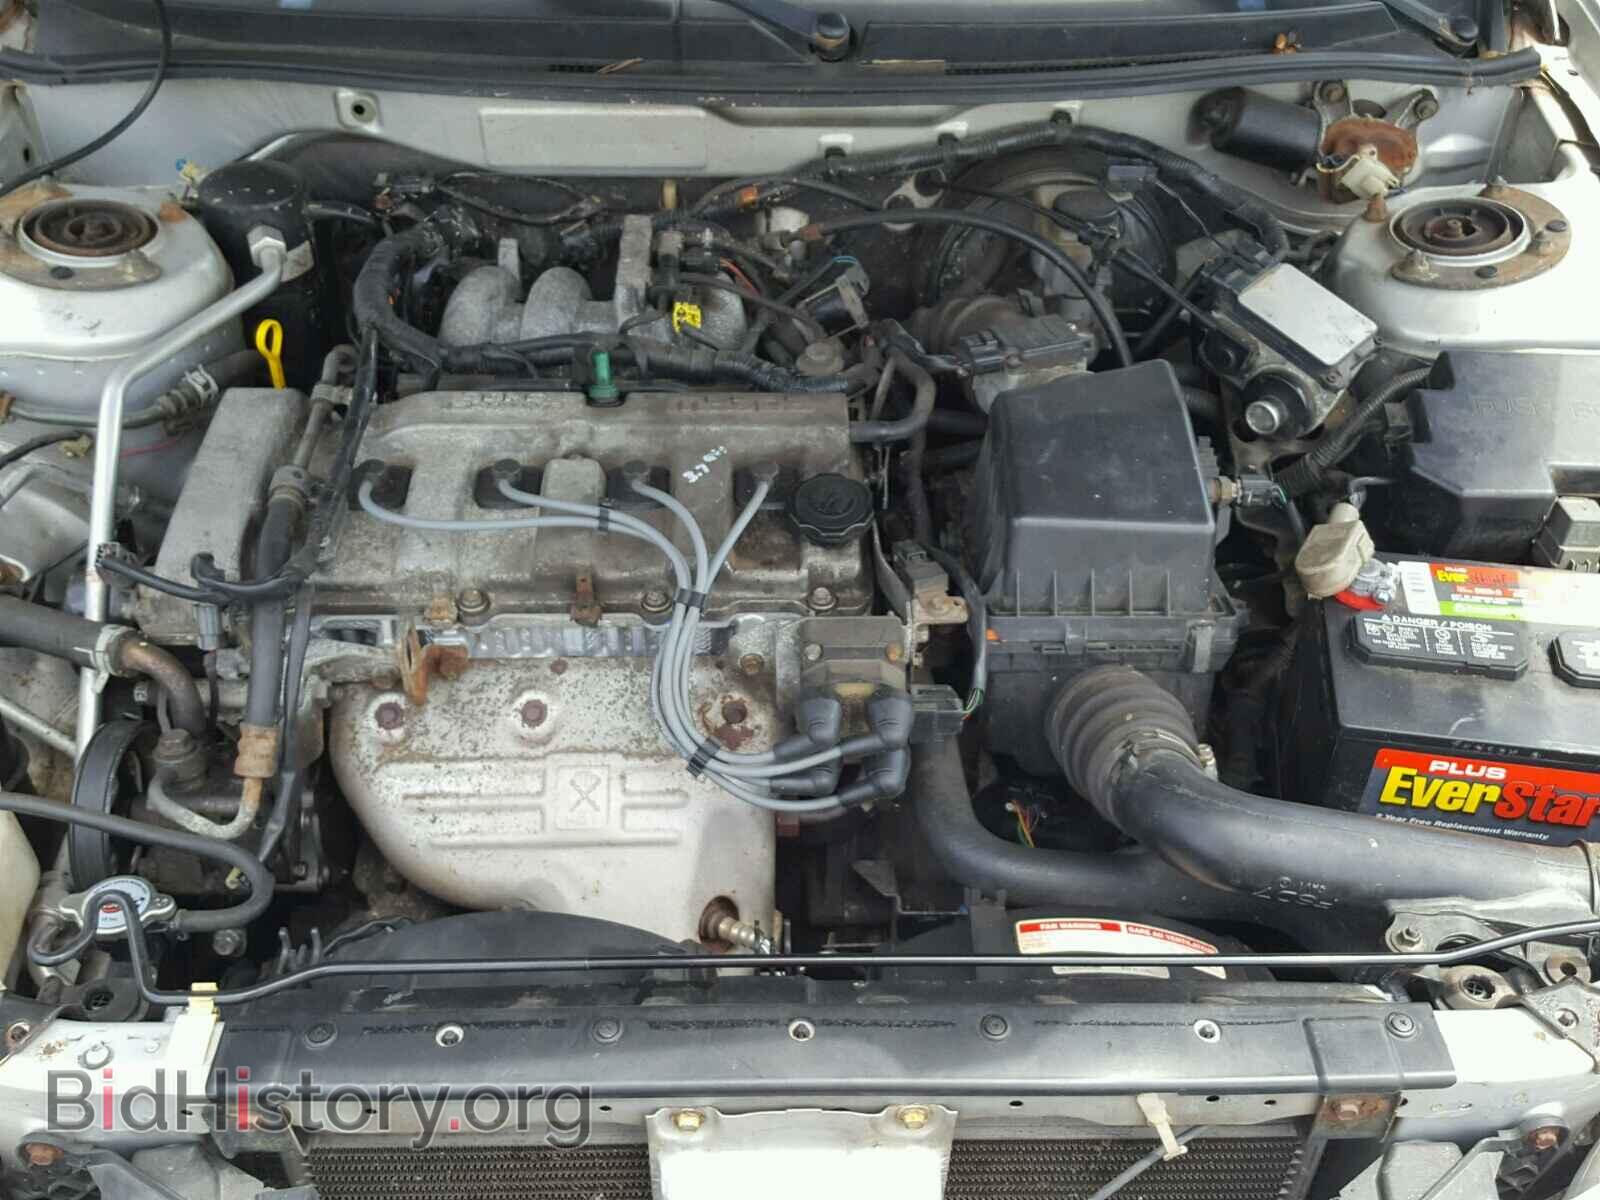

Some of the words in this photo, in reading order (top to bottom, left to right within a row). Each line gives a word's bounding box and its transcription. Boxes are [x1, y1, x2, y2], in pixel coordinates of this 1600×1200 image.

[1392, 615, 1438, 627] DANGER
[1449, 620, 1492, 632] POISON
[1429, 760, 1507, 779] PLUS
[1409, 817, 1432, 827] Free
[1433, 820, 1501, 834] Replacement
[1503, 829, 1550, 840] Warranty
